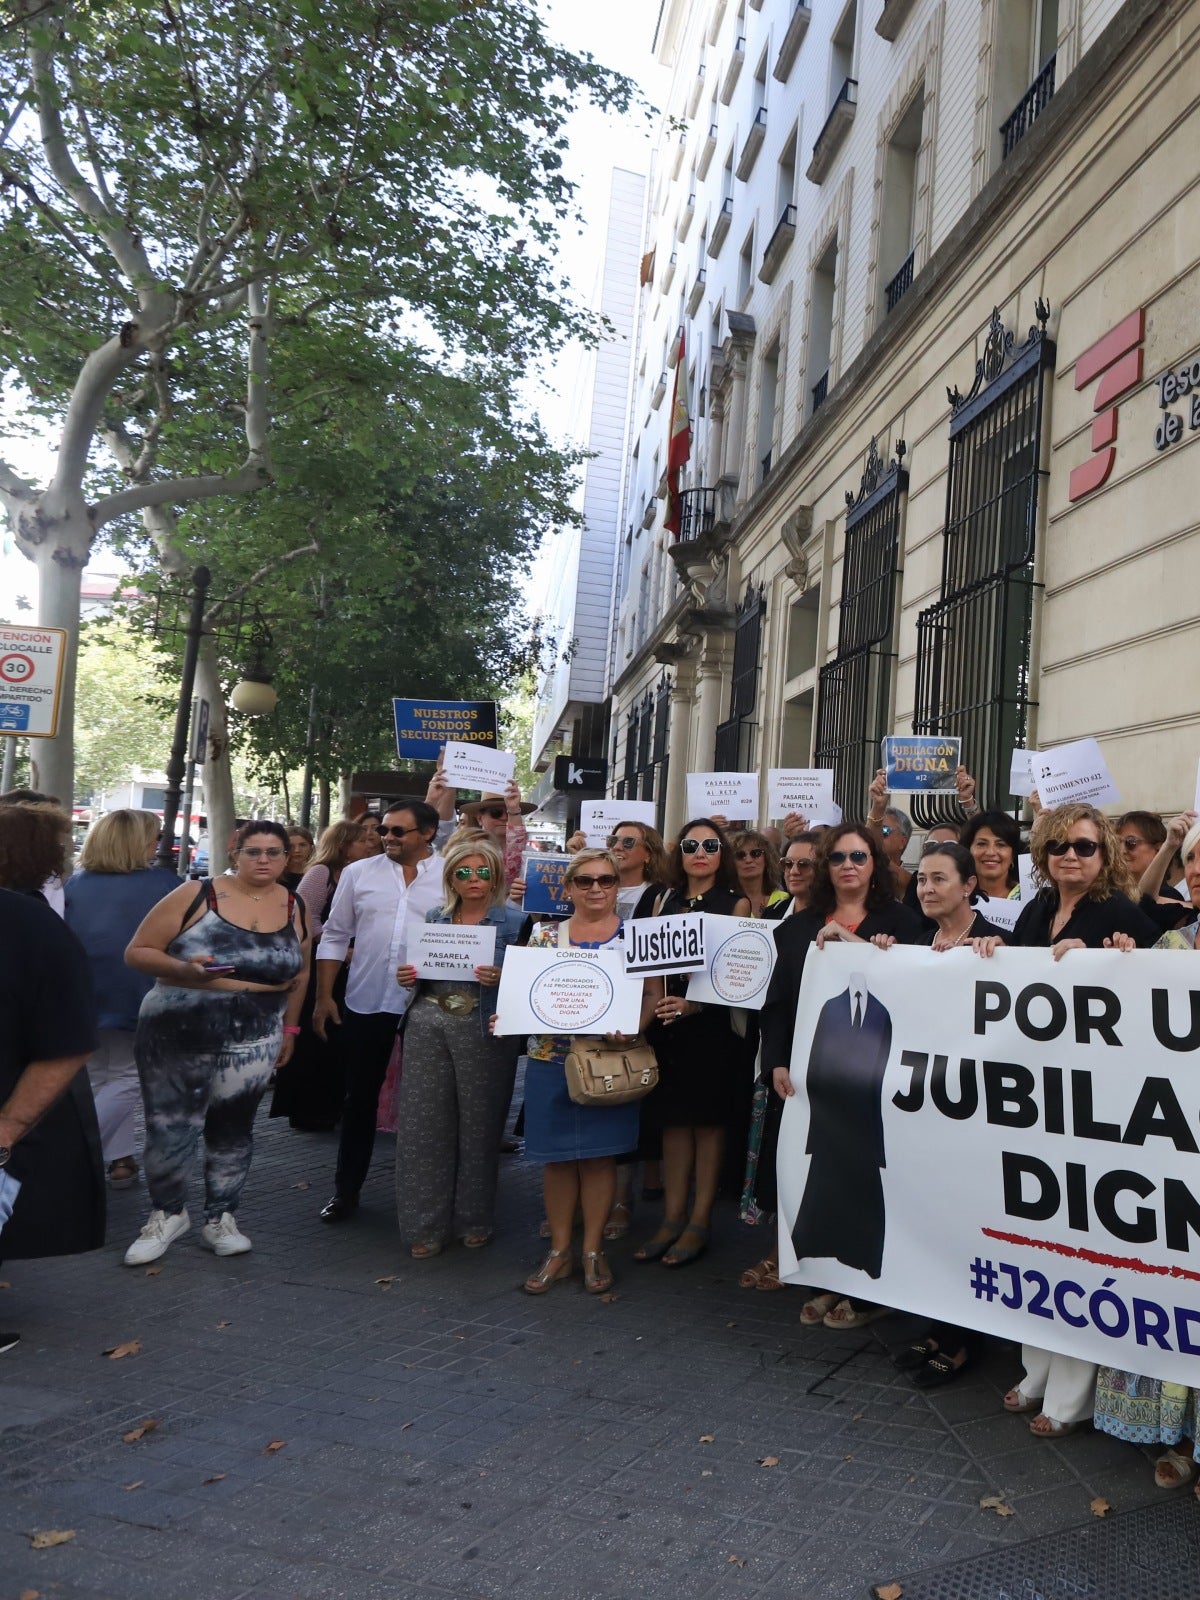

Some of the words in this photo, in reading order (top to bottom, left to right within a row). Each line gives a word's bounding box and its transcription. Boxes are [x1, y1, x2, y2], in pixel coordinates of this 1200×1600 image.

[1154, 412, 1182, 450] de
[6, 662, 26, 674] 30
[10, 685, 52, 694] DERECHO
[414, 708, 478, 719] NUESTROS
[422, 720, 472, 730] FONDOS
[400, 730, 494, 740] SECUESTRADOS
[892, 744, 954, 756] JUBILACIÓN
[895, 758, 950, 772] DIGNA
[1046, 776, 1090, 793] MOVIMIENTO
[540, 874, 554, 884] AL
[738, 921, 768, 929] CÓRDOBA
[626, 918, 704, 964] Justicia!
[974, 980, 1122, 1047] POR
